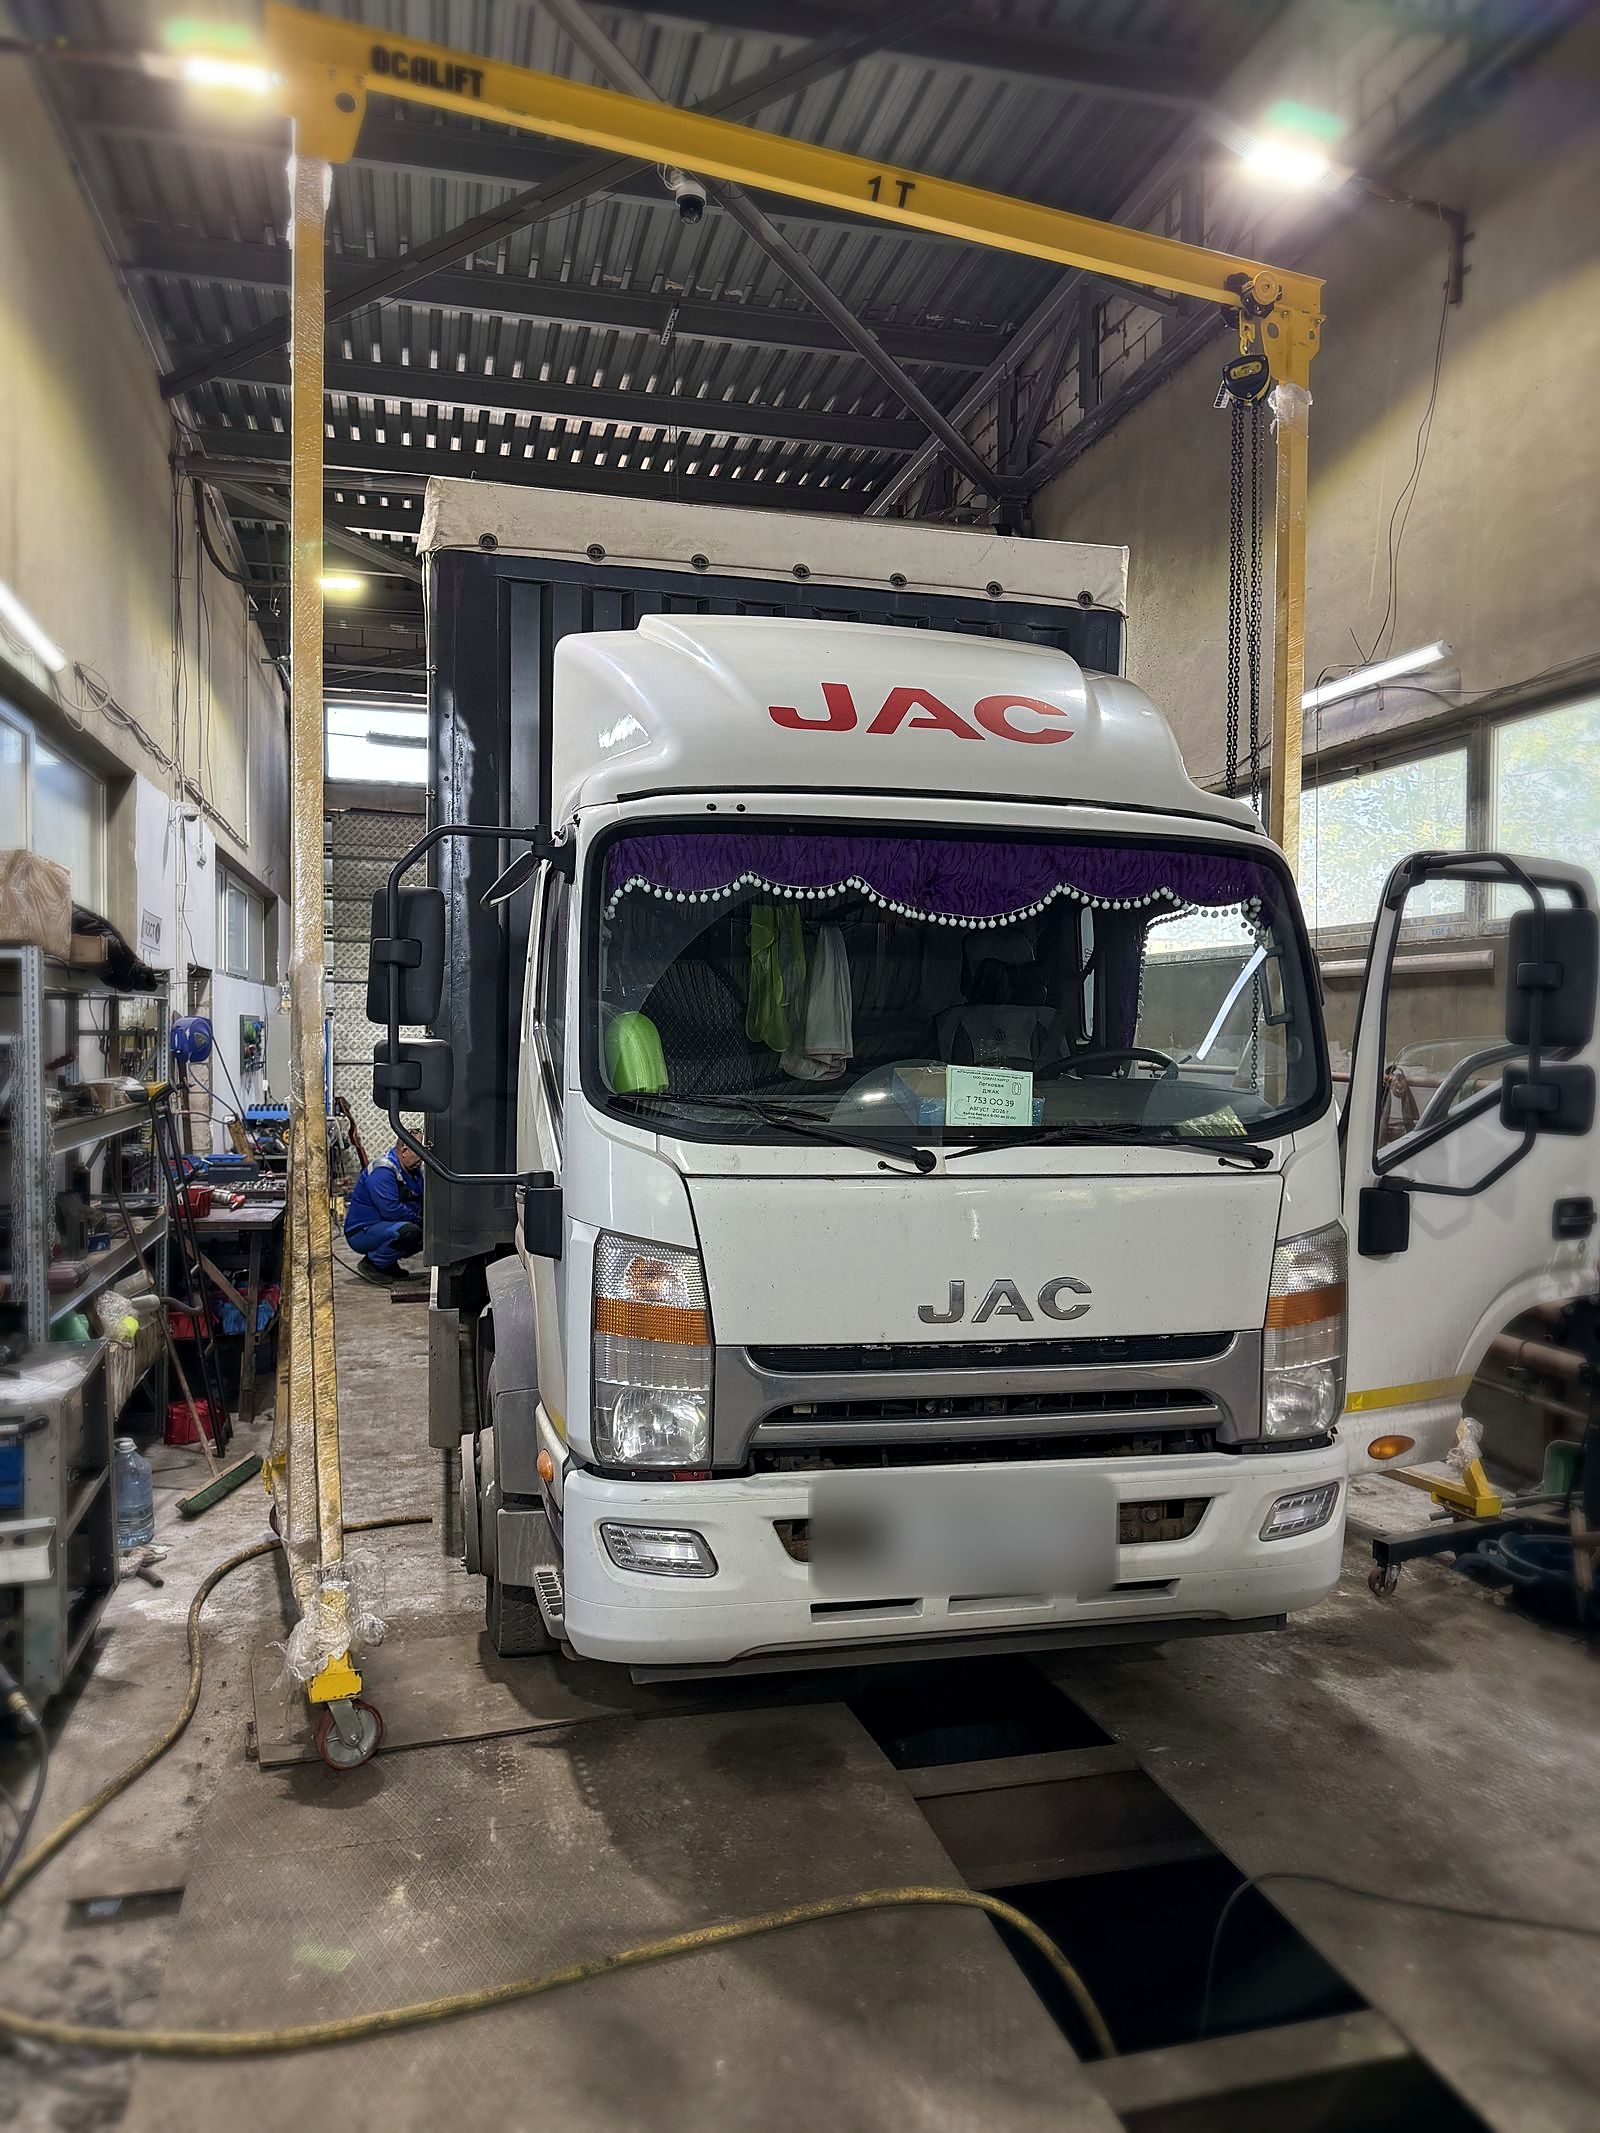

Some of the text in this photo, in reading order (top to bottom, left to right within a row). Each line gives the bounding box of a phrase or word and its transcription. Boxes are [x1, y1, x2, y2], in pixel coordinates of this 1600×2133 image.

[868, 175, 882, 202] 1
[768, 682, 1074, 745] JAC
[974, 1096, 987, 1105] 753
[918, 1276, 1093, 1324] JAC
